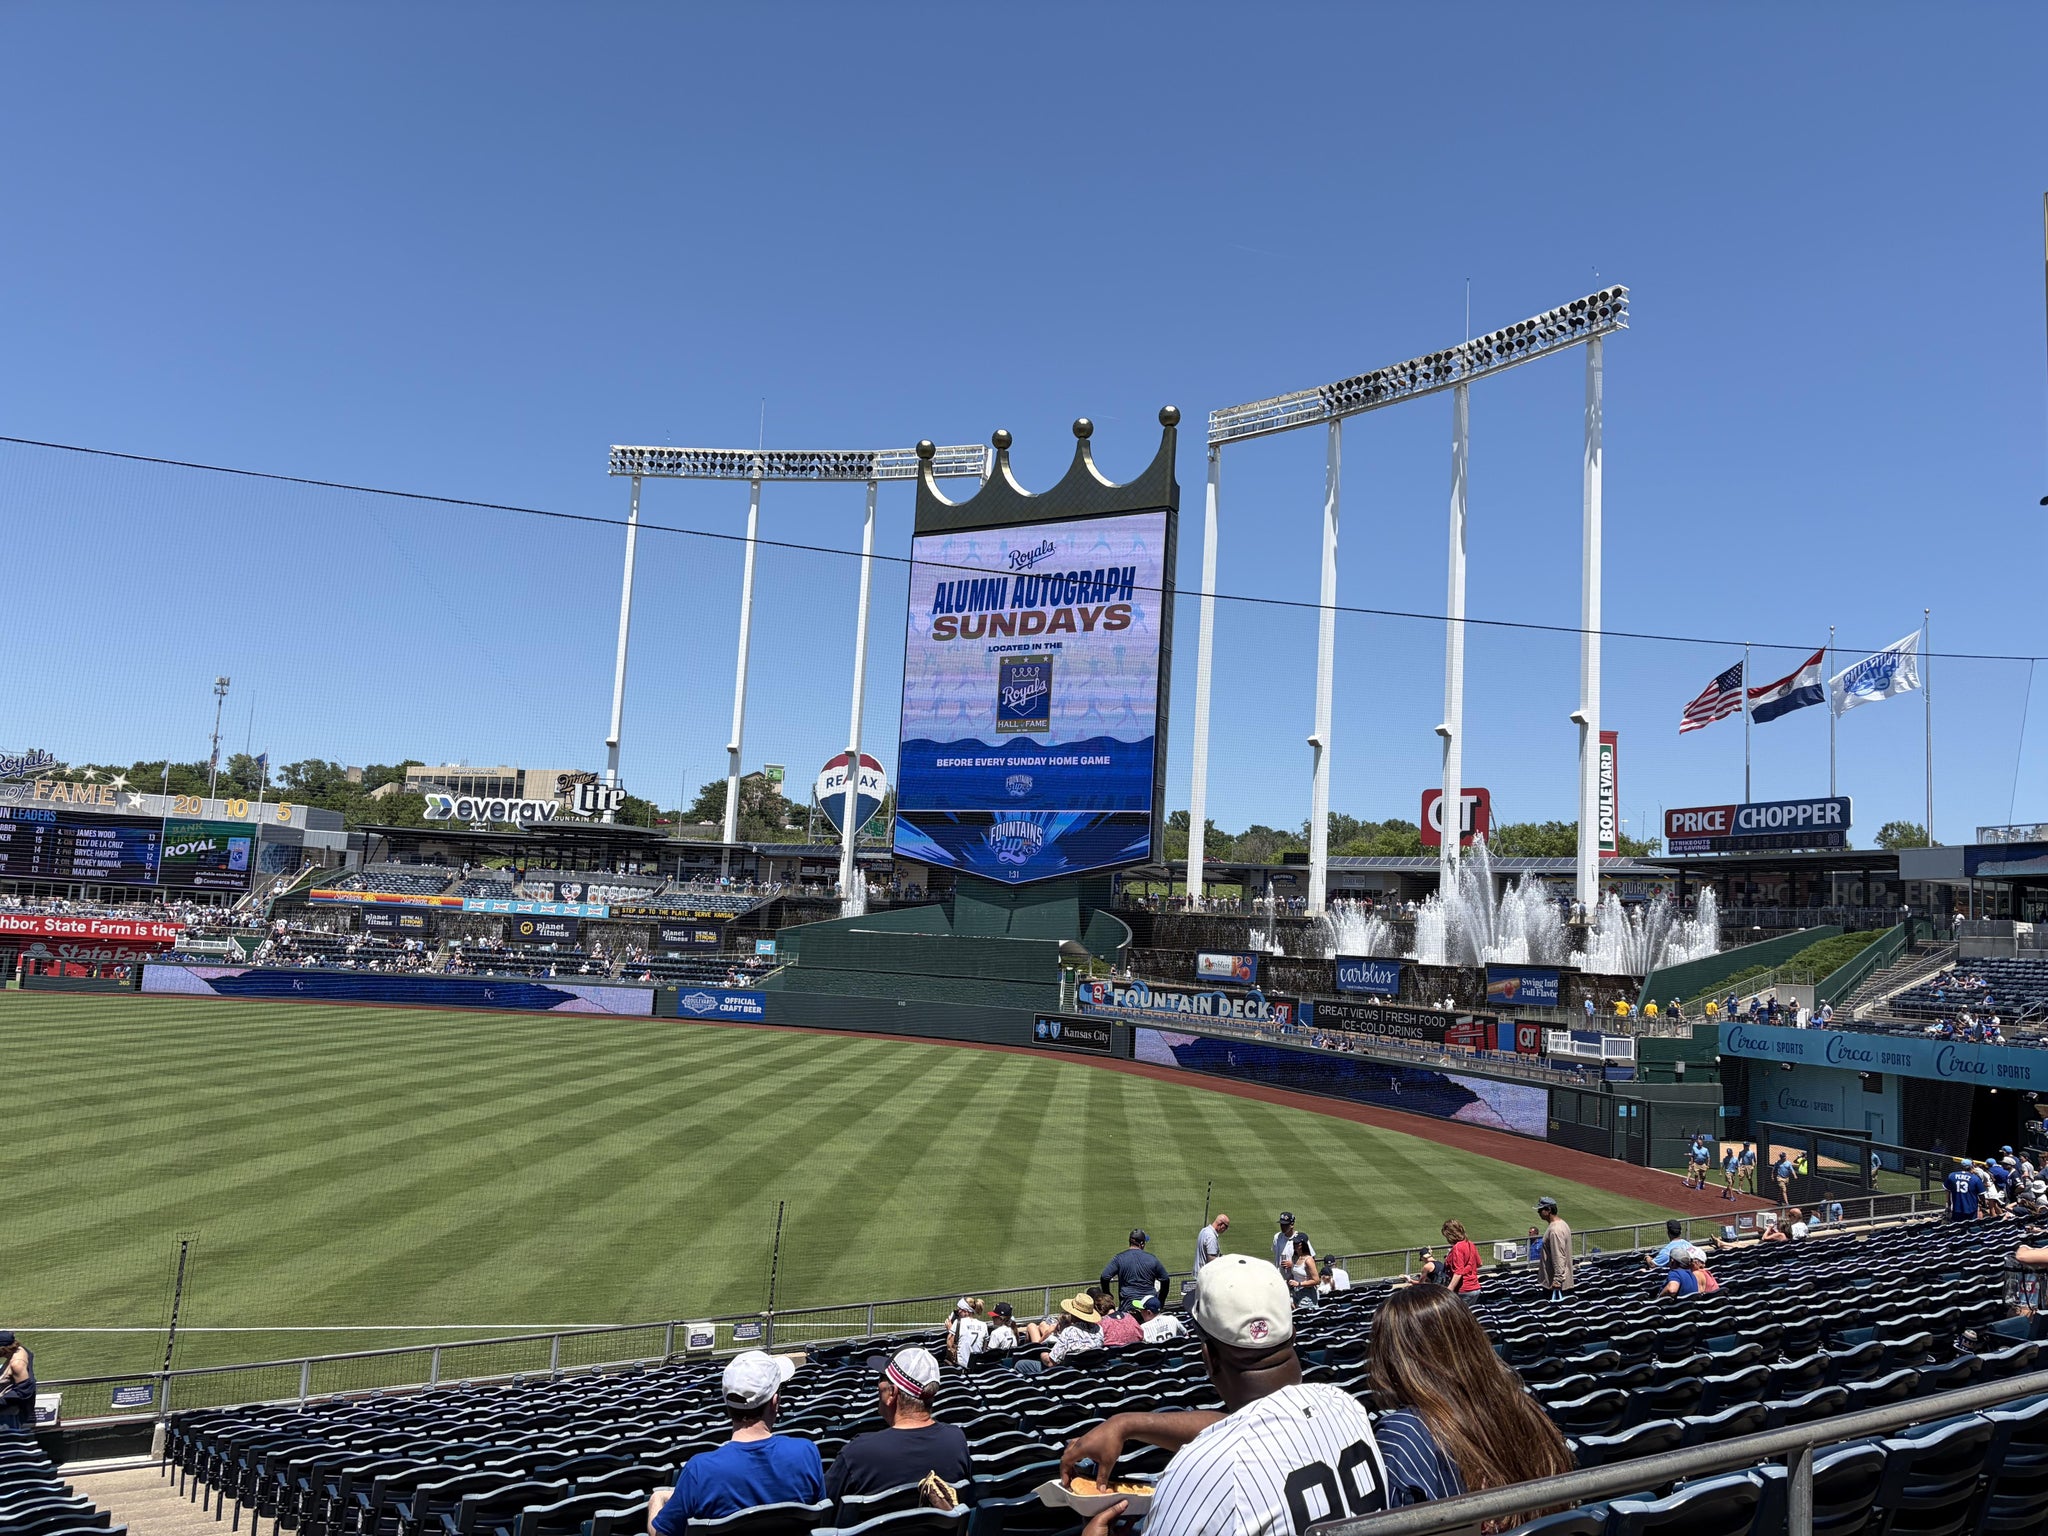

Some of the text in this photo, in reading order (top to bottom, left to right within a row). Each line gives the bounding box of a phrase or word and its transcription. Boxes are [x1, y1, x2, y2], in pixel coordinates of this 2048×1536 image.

[1008, 539, 1056, 572] Royals
[932, 566, 1136, 615] ALUMNI AUTOGRAPH
[932, 604, 1132, 641] SUNDAYS
[988, 644, 1030, 652] LOCATED
[1002, 677, 1048, 707] Royals
[936, 756, 1111, 767] BEFORE EVERY SUNDAY HOME GAME
[557, 771, 598, 792] Miller
[5, 780, 117, 806] of FAME
[570, 783, 626, 816] Lite
[1600, 751, 1613, 841] BOULEVARD
[173, 794, 203, 815] 20
[224, 798, 249, 818] 10
[277, 802, 292, 821] 5
[12, 808, 57, 822] LEADERS
[457, 797, 559, 831] evergy
[552, 815, 590, 823] OUNTAIN
[1671, 803, 1841, 832] PRICE CHOPPER
[36, 826, 44, 834] 20
[76, 829, 97, 837] JAMES
[173, 822, 203, 834] BANK
[990, 821, 1043, 847] FOUNTAINS
[35, 836, 42, 844] 15
[75, 839, 90, 847] ELLY
[107, 841, 124, 849] CRUZ
[170, 836, 194, 844] LIKE
[34, 846, 41, 854] 14
[74, 849, 94, 857] BRYCE
[94, 850, 119, 859] HARPER
[165, 839, 217, 857] ROYAL
[32, 855, 39, 863] 13
[73, 859, 121, 868] MICKEY MONIAK
[32, 865, 38, 873] 13
[87, 869, 109, 877] MUNCY
[1008, 870, 1019, 879] 1:31
[365, 913, 388, 921] planet
[367, 919, 393, 927] fitness
[44, 919, 87, 932] State
[91, 921, 131, 935] Farm
[135, 923, 147, 935] is
[536, 923, 564, 931] planet
[540, 928, 569, 937] fitness
[663, 930, 684, 938] planet
[58, 943, 113, 960] State
[1340, 962, 1396, 984] carbliss
[1522, 978, 1541, 989] Swing
[1094, 985, 1102, 1001] QT
[1522, 988, 1558, 998] Full Flavor
[720, 1004, 742, 1012] CRAFT
[725, 997, 756, 1005] OFFICIAL
[1113, 987, 1270, 1018] FOUNTAIN DECK
[1319, 1005, 1446, 1027] GREAT VIEWS FRESH FOOD
[1064, 1027, 1109, 1044] Kansas City
[1342, 1020, 1423, 1038] ICE-COLD DRINKS
[1519, 1027, 1536, 1048] QT
[1727, 1026, 1803, 1055] Circa SPORTS
[1826, 1035, 1911, 1067] Circa SPORTS
[1936, 1045, 2030, 1080] Circa SPORTS
[1778, 1088, 1834, 1113] Circa SPORTS
[1955, 1180, 1969, 1193] 13
[971, 1332, 979, 1347] 7
